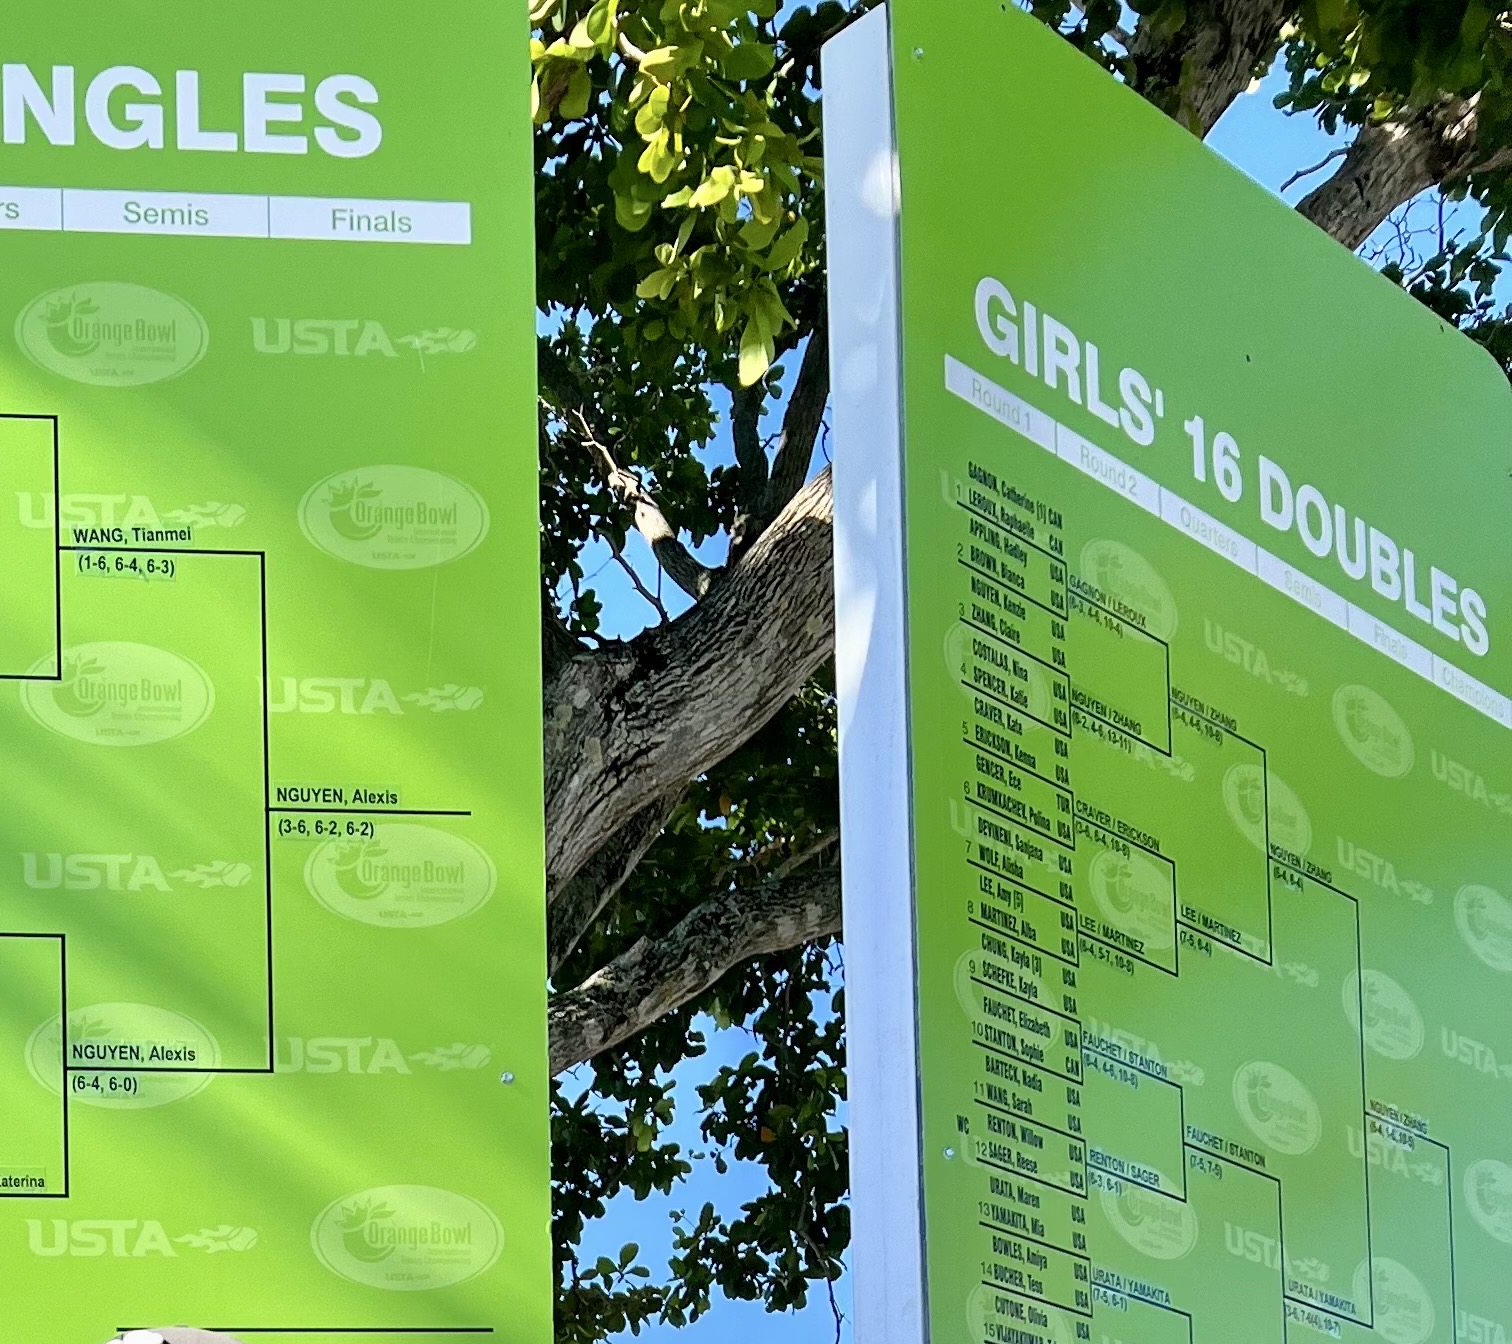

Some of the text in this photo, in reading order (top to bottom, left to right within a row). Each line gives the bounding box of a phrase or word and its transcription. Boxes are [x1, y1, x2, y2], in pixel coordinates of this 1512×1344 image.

[123, 202, 209, 227] Semis
[331, 208, 412, 233] Finals
[250, 316, 400, 356] USTA
[972, 377, 1031, 432] Round 1
[975, 276, 1489, 656] GIRLS' 16 DOUBLES
[1080, 444, 1137, 496] Round 2
[73, 526, 191, 546] WANG, Tianmei
[1180, 506, 1238, 556] Quarters
[79, 555, 175, 577] (1-6, 6-4, 6-3)
[1285, 571, 1322, 608] Semis
[1374, 624, 1407, 659] Finals
[1443, 667, 1504, 718] Champions
[277, 787, 398, 806] NGUYEN, Alexis
[279, 819, 374, 839] (3-6, 6-2, 6-2)
